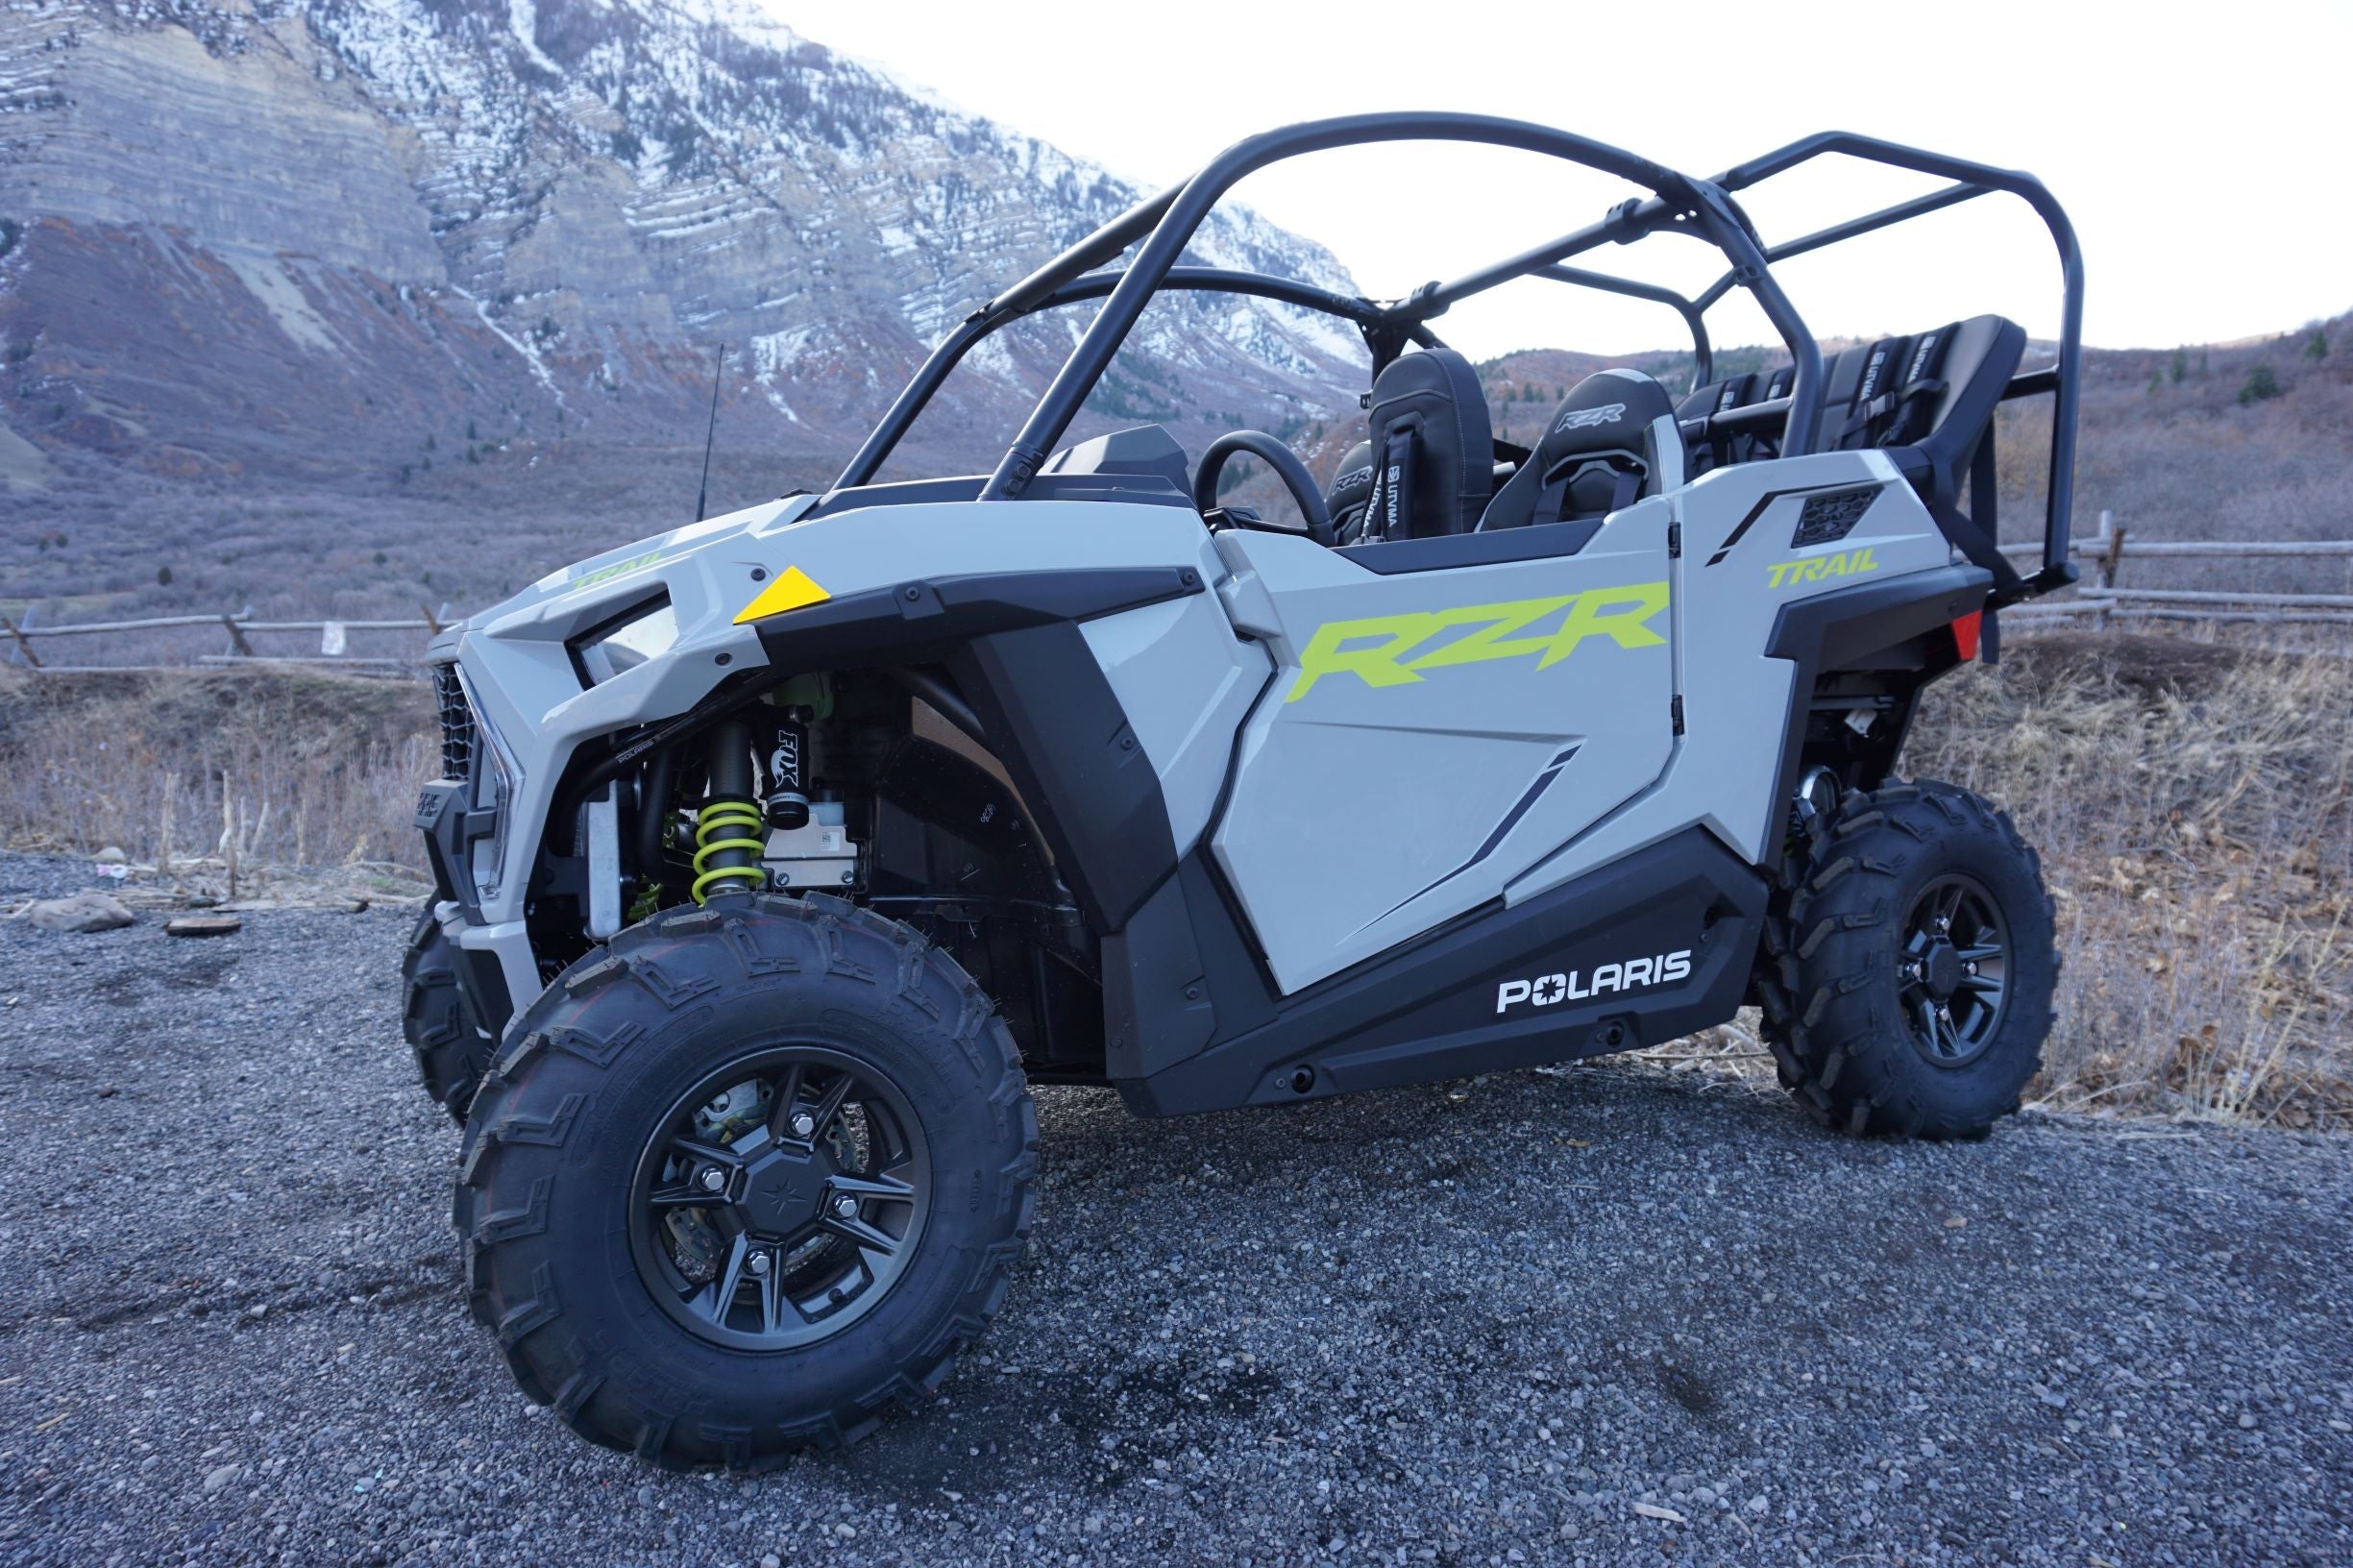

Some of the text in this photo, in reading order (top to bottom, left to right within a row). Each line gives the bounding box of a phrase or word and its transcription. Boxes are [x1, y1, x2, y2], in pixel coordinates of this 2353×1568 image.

[1554, 403, 1626, 433] RZR
[1332, 465, 1373, 496] RZR
[1363, 487, 1382, 527] UTVMA
[1387, 484, 1398, 527] UTVMA
[1766, 547, 1879, 590] TRAIL
[1285, 581, 1670, 703] RZR
[617, 738, 654, 764] POLARIS
[771, 729, 798, 788] FOX
[1497, 949, 1691, 1014] POLARIS
